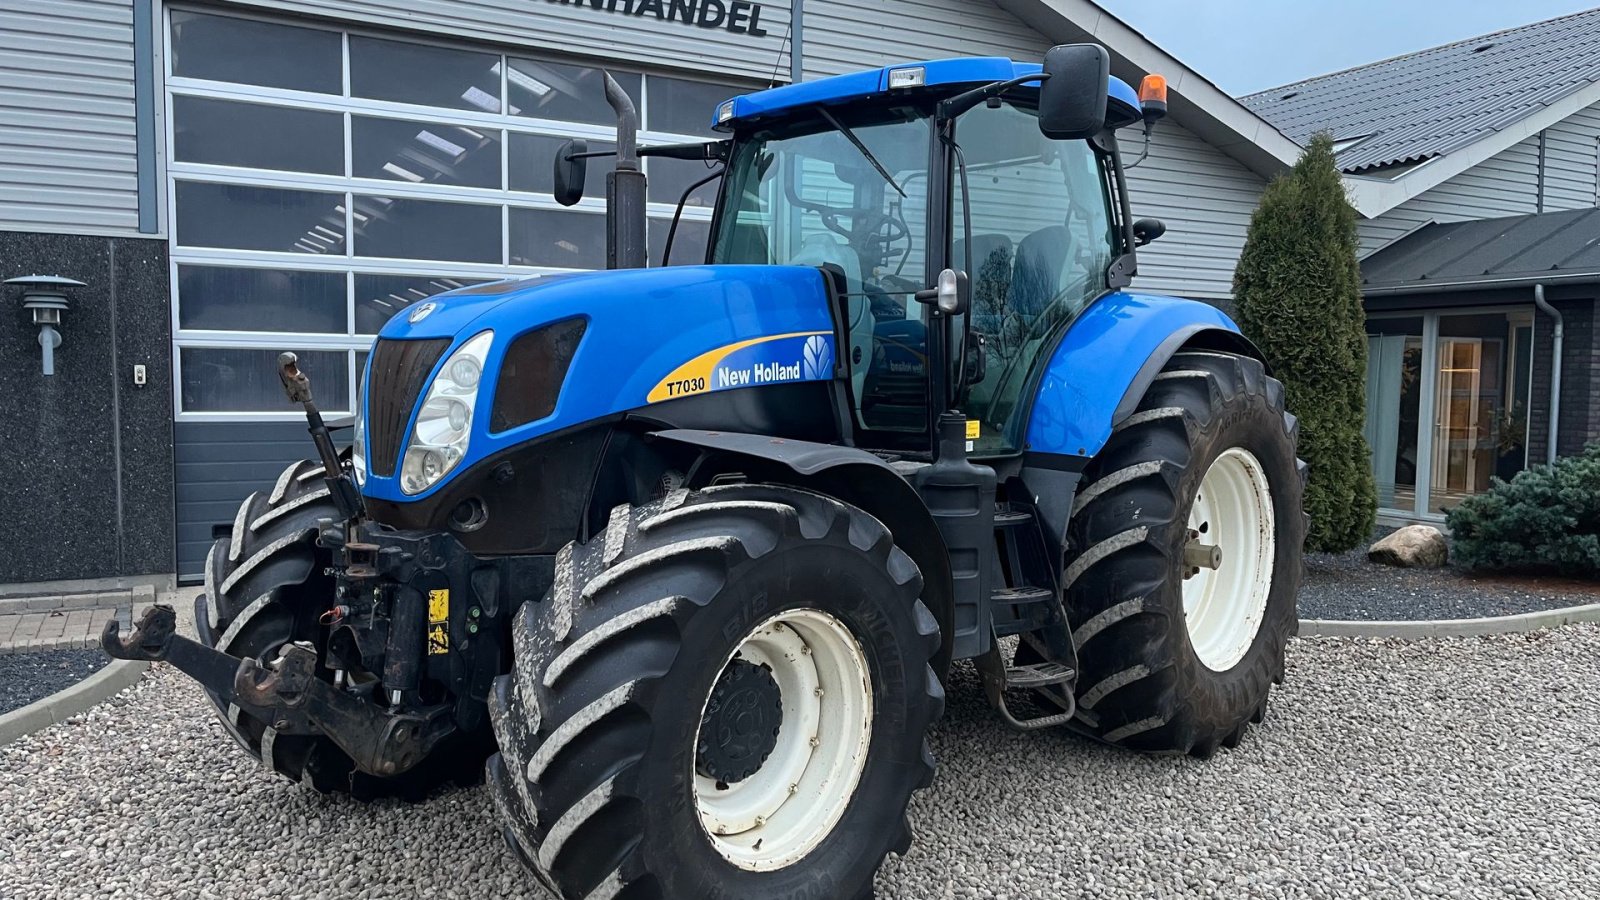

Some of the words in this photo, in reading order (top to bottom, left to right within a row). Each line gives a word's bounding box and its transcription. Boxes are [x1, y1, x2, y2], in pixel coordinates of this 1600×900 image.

[546, 0, 767, 37] HANDEL
[667, 377, 705, 396] T7030
[718, 367, 750, 388] New
[754, 361, 800, 383] Holland
